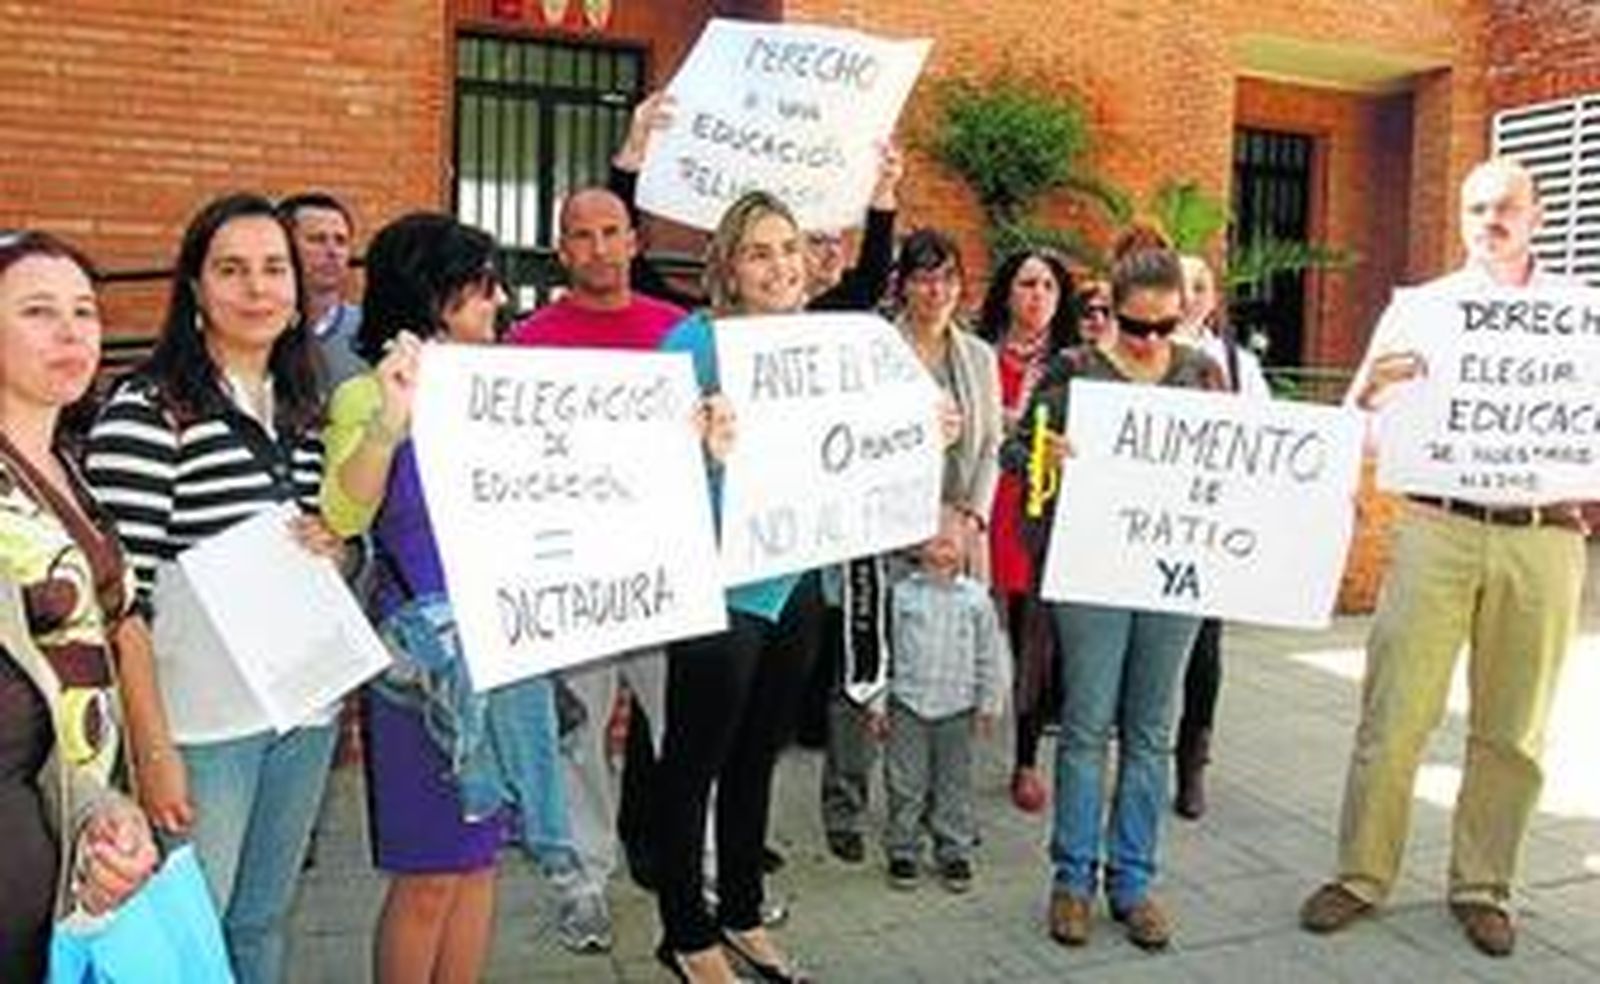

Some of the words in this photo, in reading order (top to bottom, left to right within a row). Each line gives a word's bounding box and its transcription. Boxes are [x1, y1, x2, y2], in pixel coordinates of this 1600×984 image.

[745, 37, 879, 88] DERECHO
[1458, 299, 1600, 335] DERECH
[752, 346, 826, 400] ANTE
[1460, 353, 1577, 386] ELEGIR
[1113, 408, 1327, 483] ALIMENTO
[1119, 507, 1258, 559] RATIO
[1156, 557, 1201, 600] YA
[496, 565, 674, 646] DICTADURA
